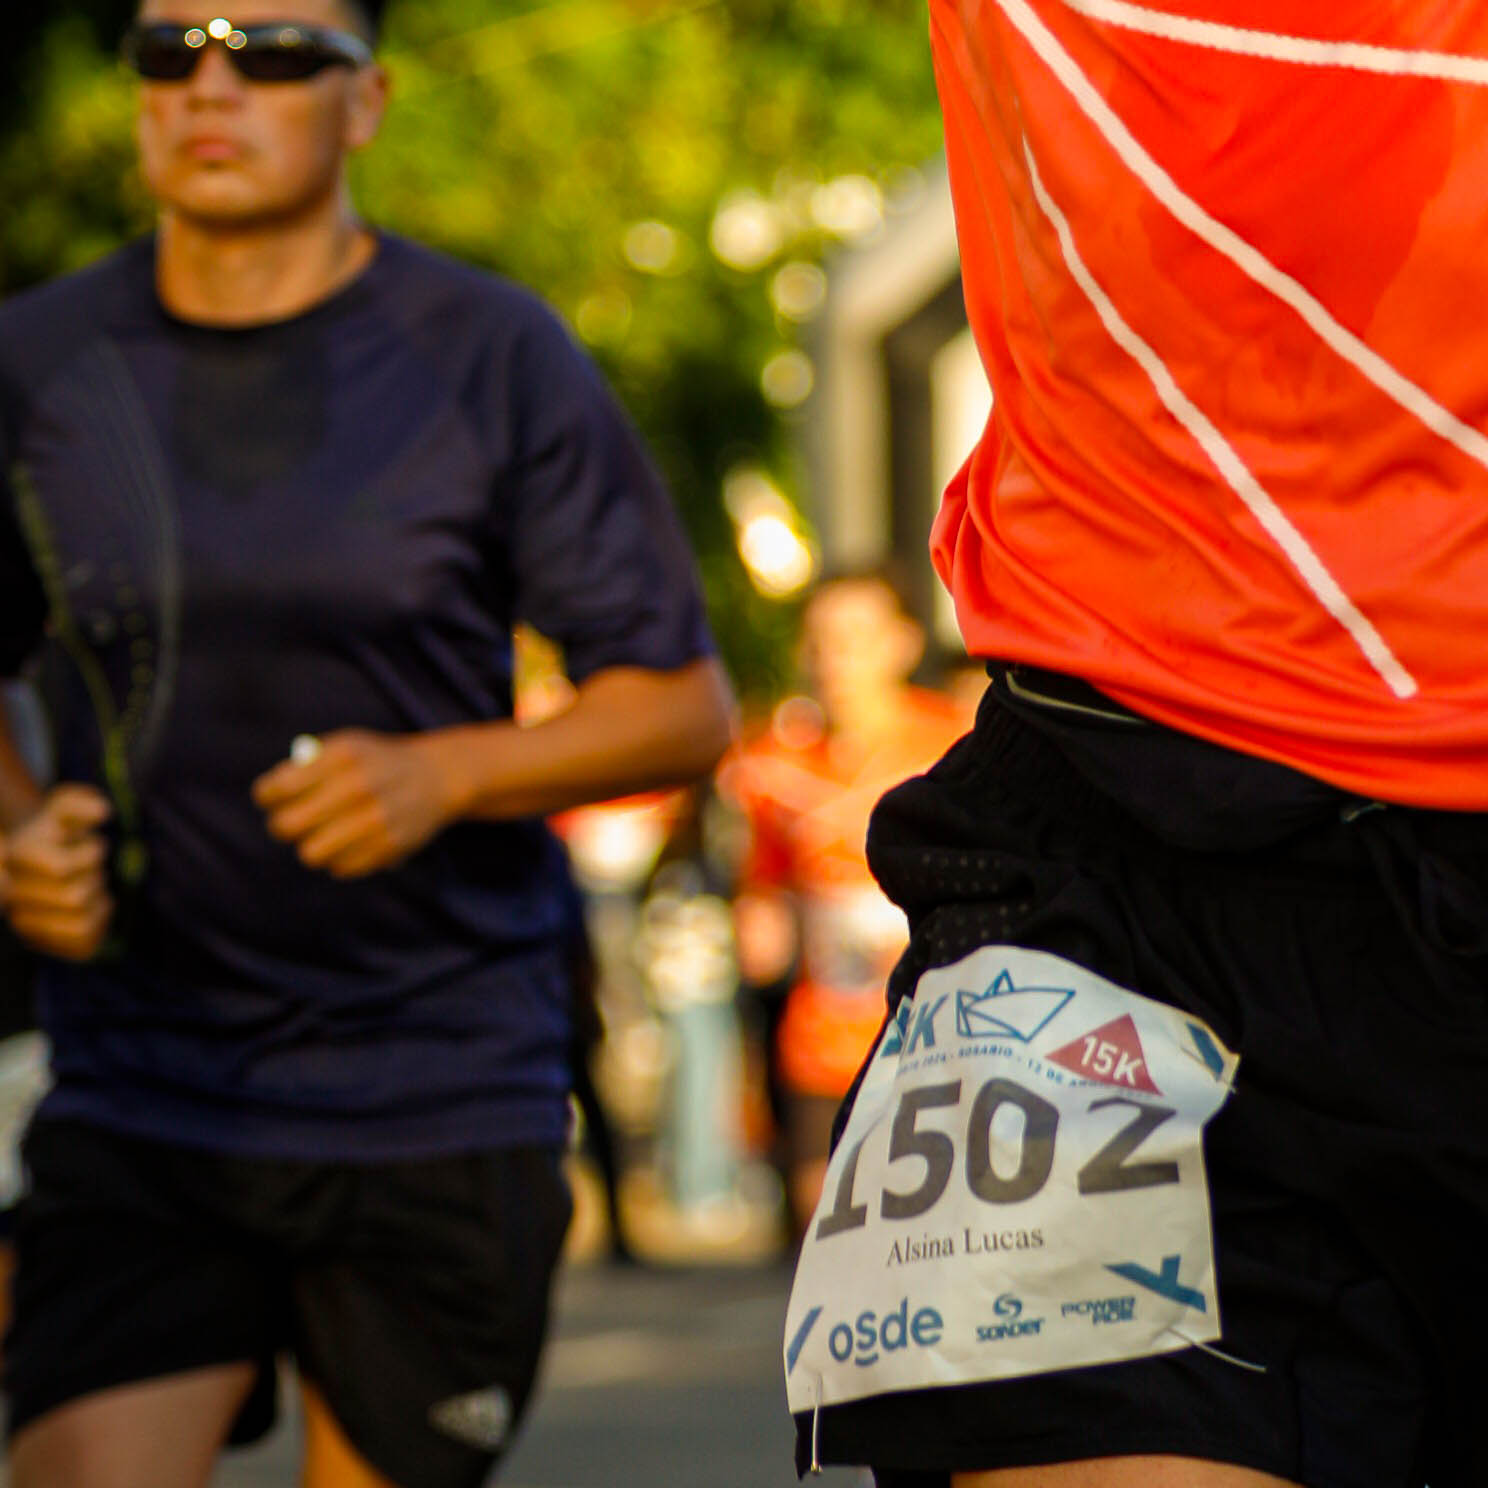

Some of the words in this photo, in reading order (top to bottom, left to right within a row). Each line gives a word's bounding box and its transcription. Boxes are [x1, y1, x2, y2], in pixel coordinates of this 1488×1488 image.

[1080, 1035, 1142, 1086] 15K
[815, 1078, 1181, 1241] 1502
[887, 1235, 955, 1268] Alsina
[963, 1226, 1045, 1255] Lucas
[828, 1297, 944, 1363] osde
[1061, 1296, 1136, 1318] POWER
